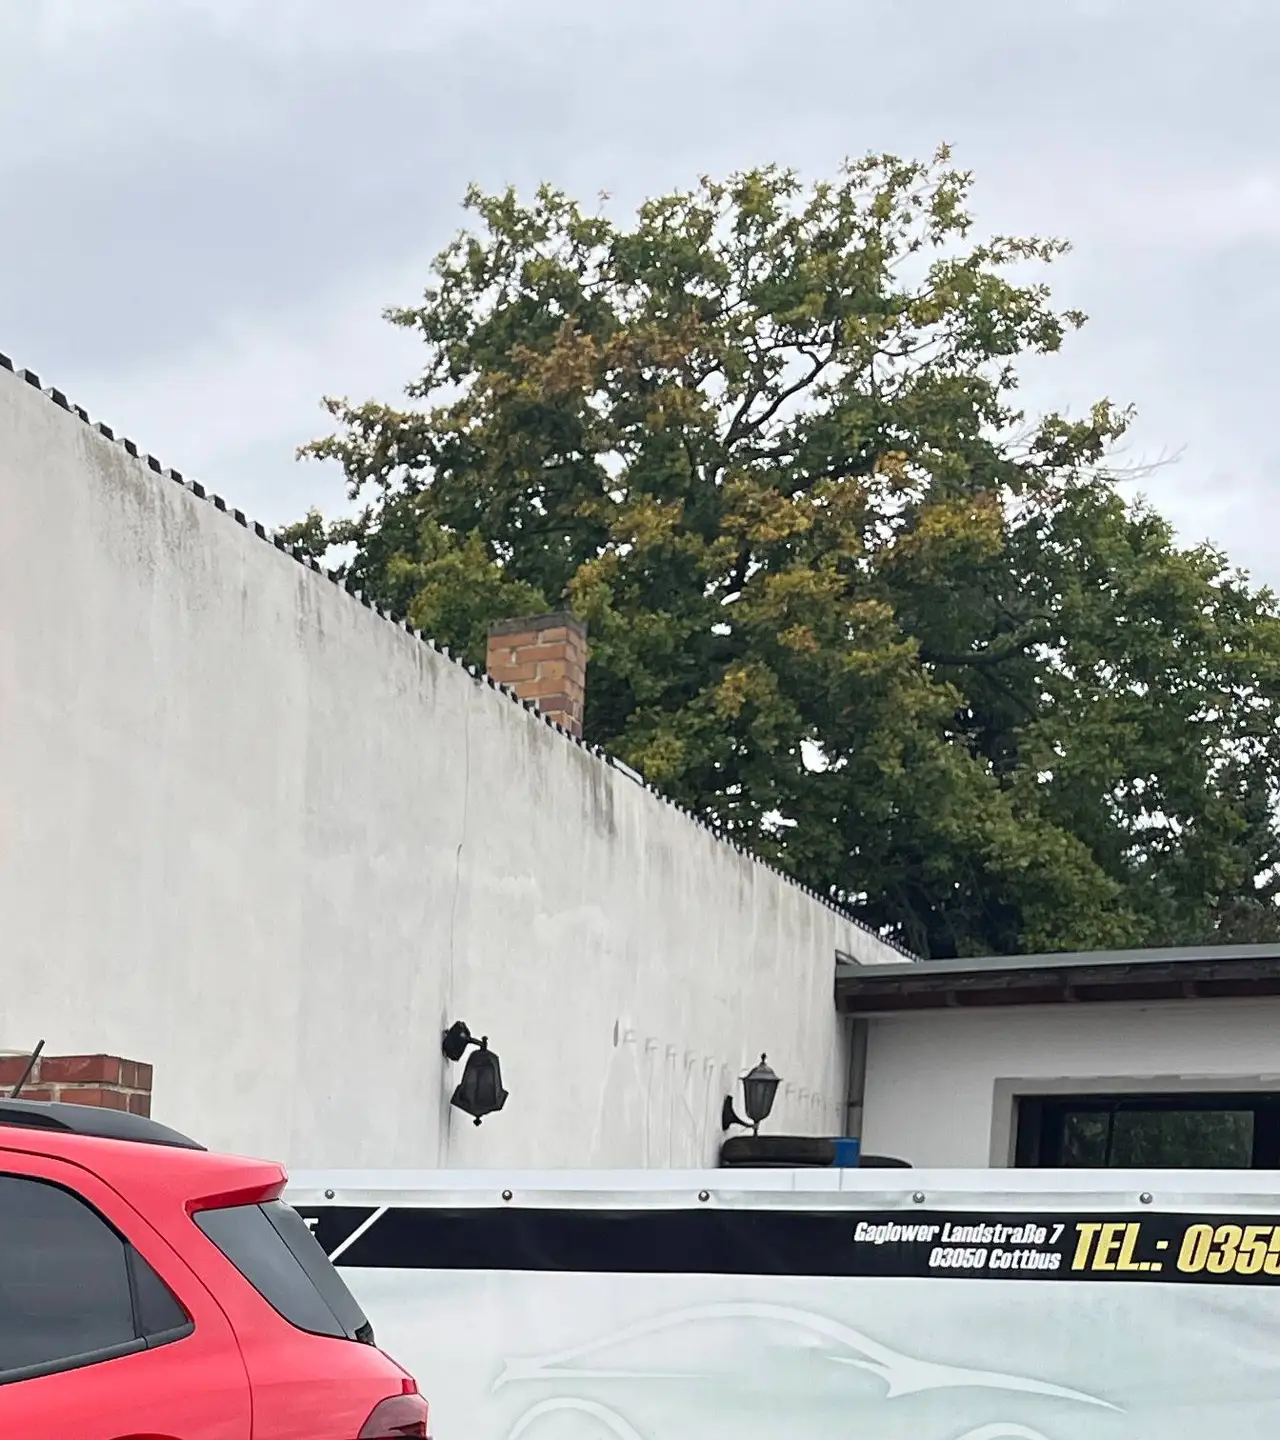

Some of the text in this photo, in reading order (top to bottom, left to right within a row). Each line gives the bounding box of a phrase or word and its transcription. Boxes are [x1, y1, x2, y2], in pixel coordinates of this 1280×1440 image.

[853, 1221, 1066, 1245] Gaglower Landstraße 7
[928, 1247, 1062, 1270] 03050 Cottbus
[1070, 1222, 1169, 1272] TEL.:
